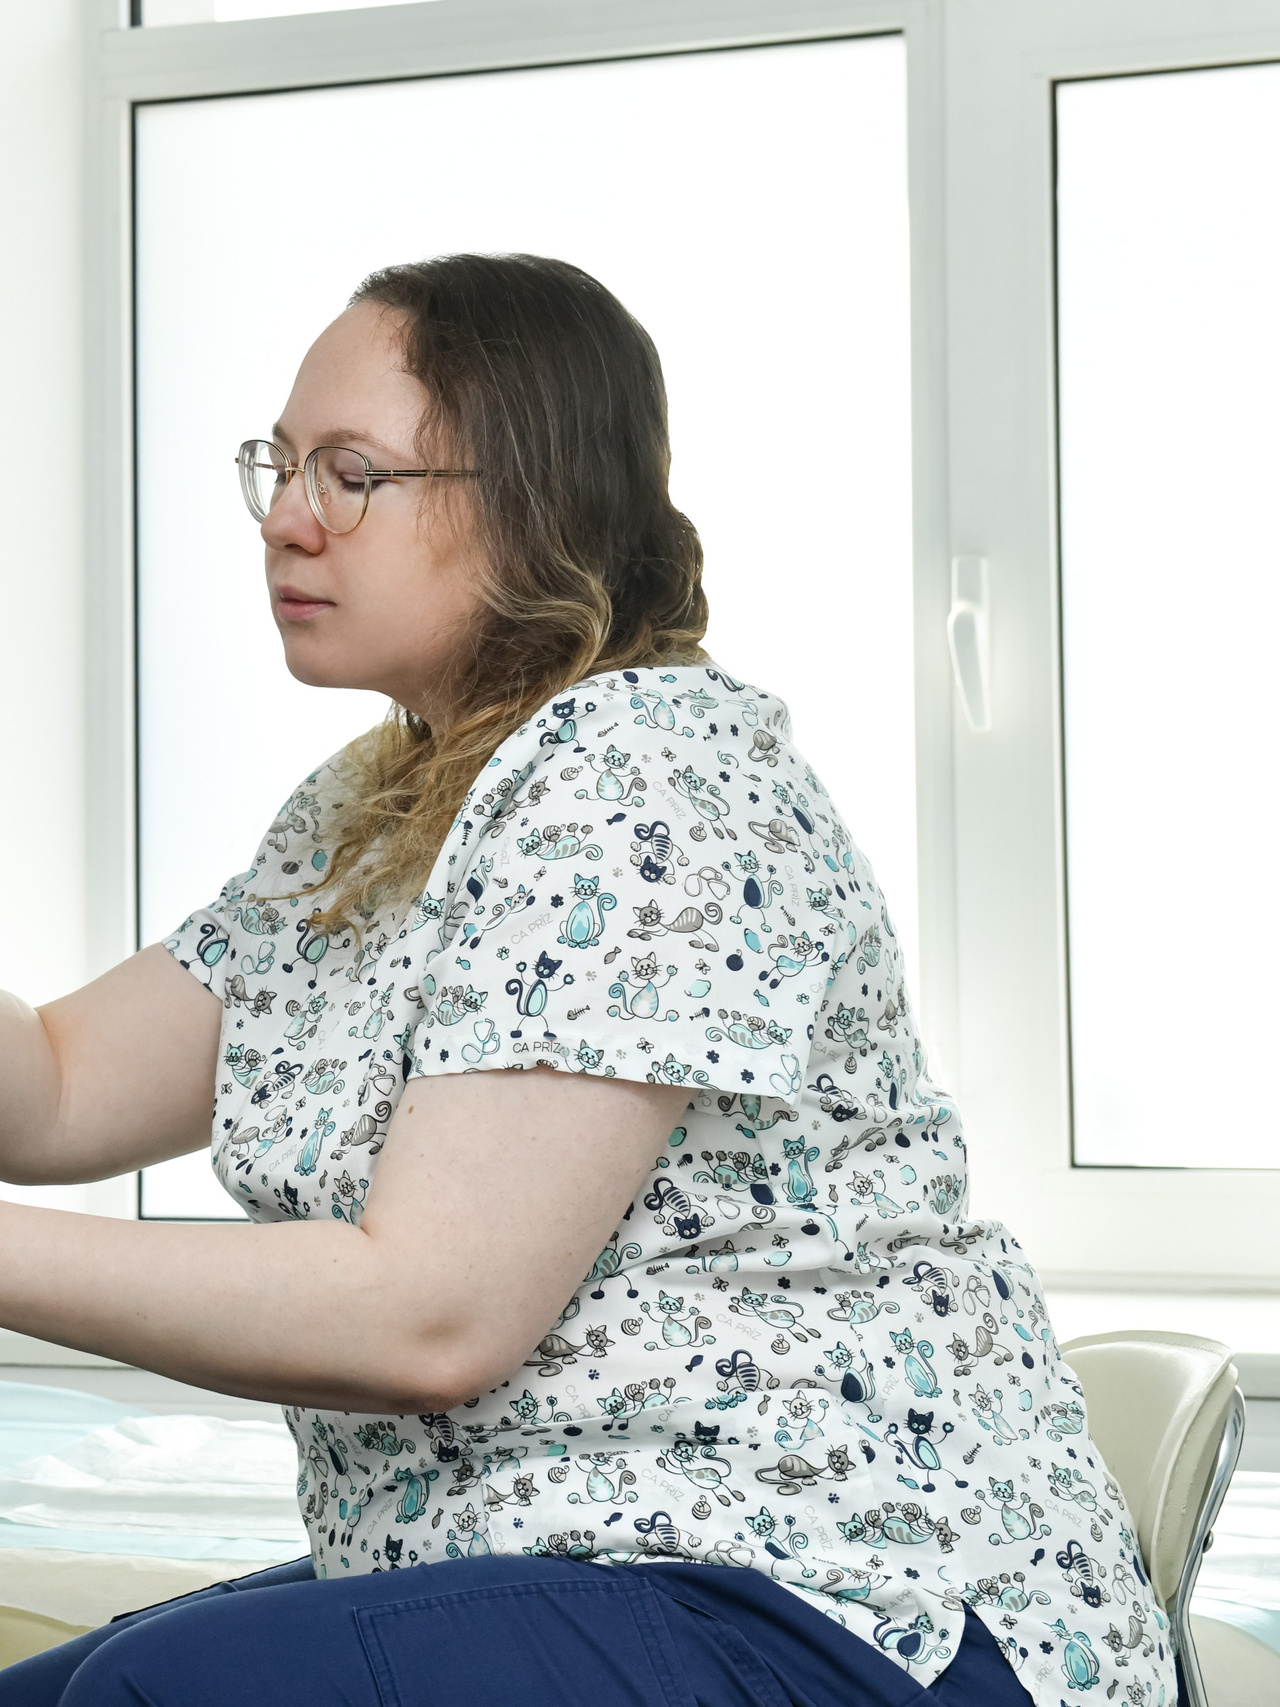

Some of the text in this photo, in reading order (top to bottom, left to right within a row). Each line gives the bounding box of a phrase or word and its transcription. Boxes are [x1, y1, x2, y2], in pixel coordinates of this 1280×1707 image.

[510, 930, 529, 945] CA
[513, 1042, 530, 1054] CA
[716, 1314, 733, 1328] CA
